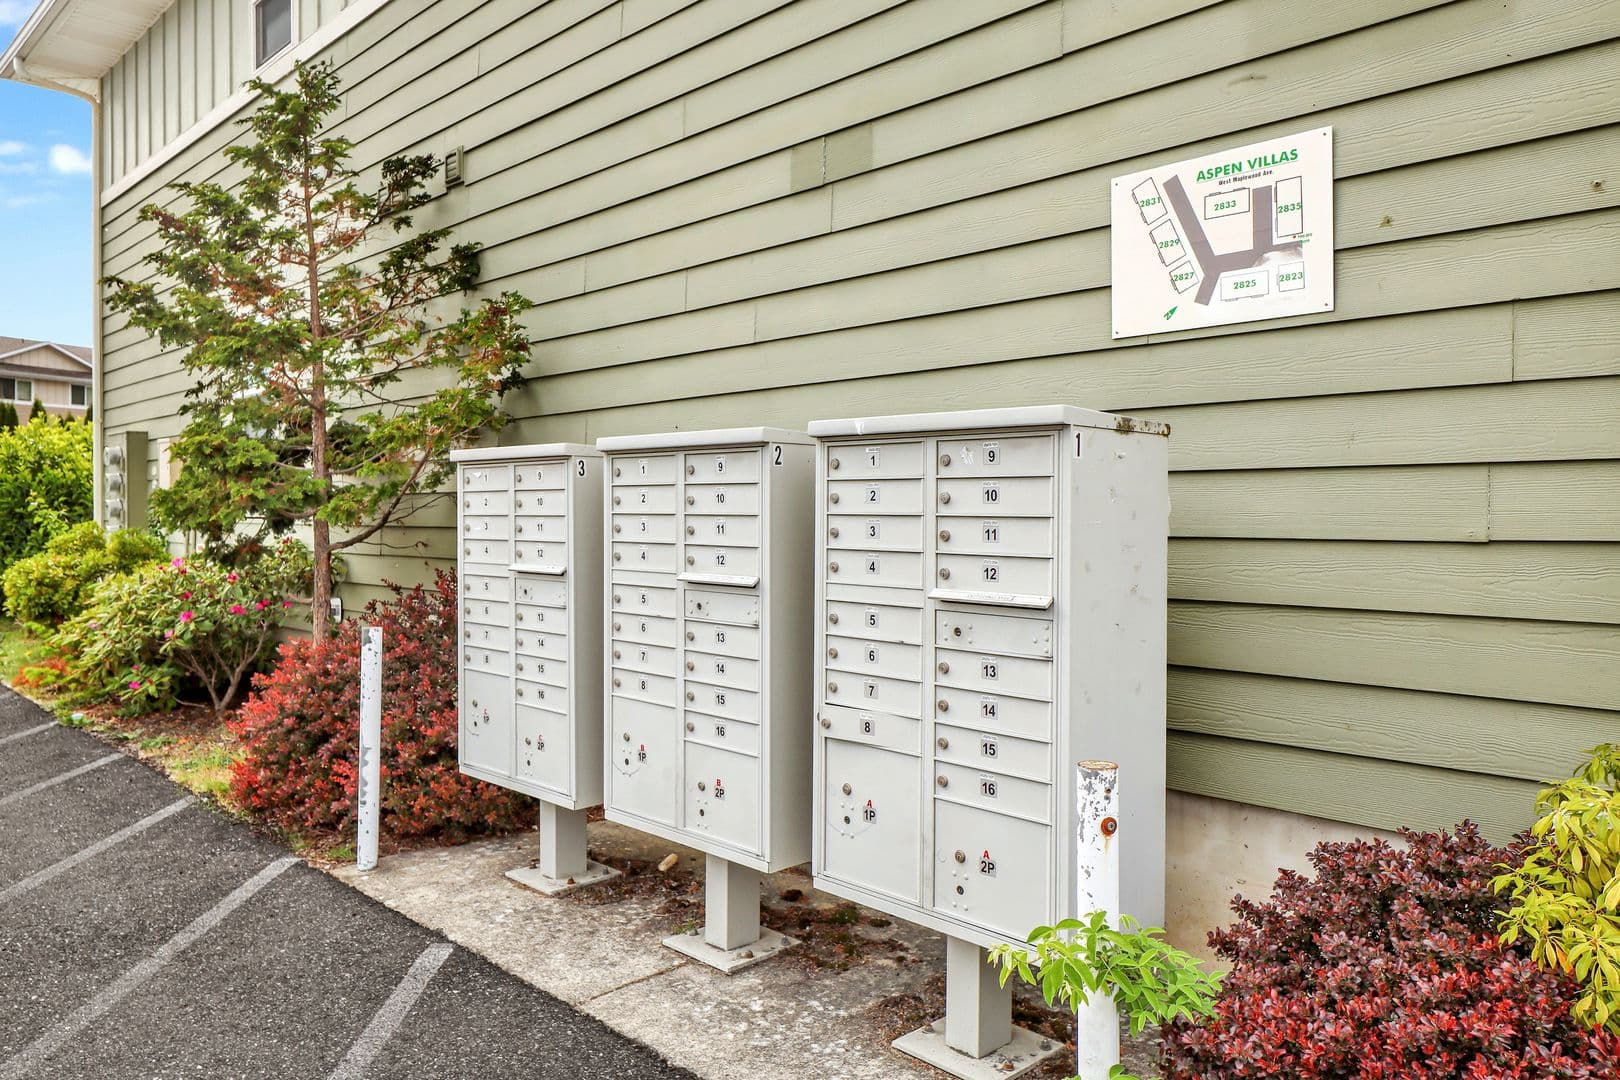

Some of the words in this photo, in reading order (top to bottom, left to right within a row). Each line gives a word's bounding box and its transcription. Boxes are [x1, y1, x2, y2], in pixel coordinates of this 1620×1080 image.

[1196, 162, 1242, 181] ASPEN
[1247, 148, 1298, 170] VILLAS
[1219, 178, 1231, 186] West
[1233, 171, 1261, 182] Maplewood
[1140, 196, 1161, 208] 2831
[1214, 200, 1237, 211] 2833
[1278, 202, 1302, 213] 2835
[1159, 238, 1180, 249] 2829
[1173, 271, 1195, 282] 2827
[1279, 271, 1304, 282] 2823
[1233, 279, 1256, 290] 2825
[1075, 432, 1081, 457] 1
[774, 445, 782, 466] 2
[870, 455, 875, 466] 1
[988, 450, 996, 463] 9
[578, 460, 585, 477] 3
[641, 465, 645, 474] 1
[718, 462, 723, 472] 9
[537, 471, 542, 481] 9
[641, 493, 646, 503] 2
[716, 493, 725, 504] 10
[870, 490, 876, 502] 2
[984, 489, 998, 502] 10
[537, 497, 543, 506] 10
[537, 523, 543, 531] 11
[641, 522, 646, 532] 3
[716, 524, 725, 534] 11
[870, 525, 876, 537] 3
[984, 528, 997, 541] 11
[537, 549, 543, 558] 12
[641, 551, 646, 560] 4
[716, 555, 725, 565] 12
[869, 561, 876, 573] 4
[983, 567, 997, 580] 12
[641, 594, 646, 604] 5
[537, 613, 544, 622] 13
[869, 614, 876, 626] 5
[641, 622, 646, 633] 6
[538, 639, 544, 647] 14
[716, 632, 725, 643] 13
[641, 651, 646, 661] 7
[869, 650, 875, 662] 6
[537, 664, 545, 673] 15
[716, 663, 725, 674] 14
[983, 664, 996, 678] 13
[641, 680, 646, 690] 8
[538, 690, 545, 700] 16
[868, 685, 875, 697] 7
[716, 694, 725, 705] 15
[982, 703, 996, 717] 14
[716, 726, 725, 737] 16
[864, 721, 871, 733] 8
[982, 742, 996, 756] 15
[638, 752, 647, 762] 1P
[715, 788, 725, 798] 2P
[982, 782, 996, 796] 16
[867, 800, 872, 808] A
[864, 809, 876, 821] 1P
[983, 850, 990, 859] A
[980, 861, 995, 874] 2P
